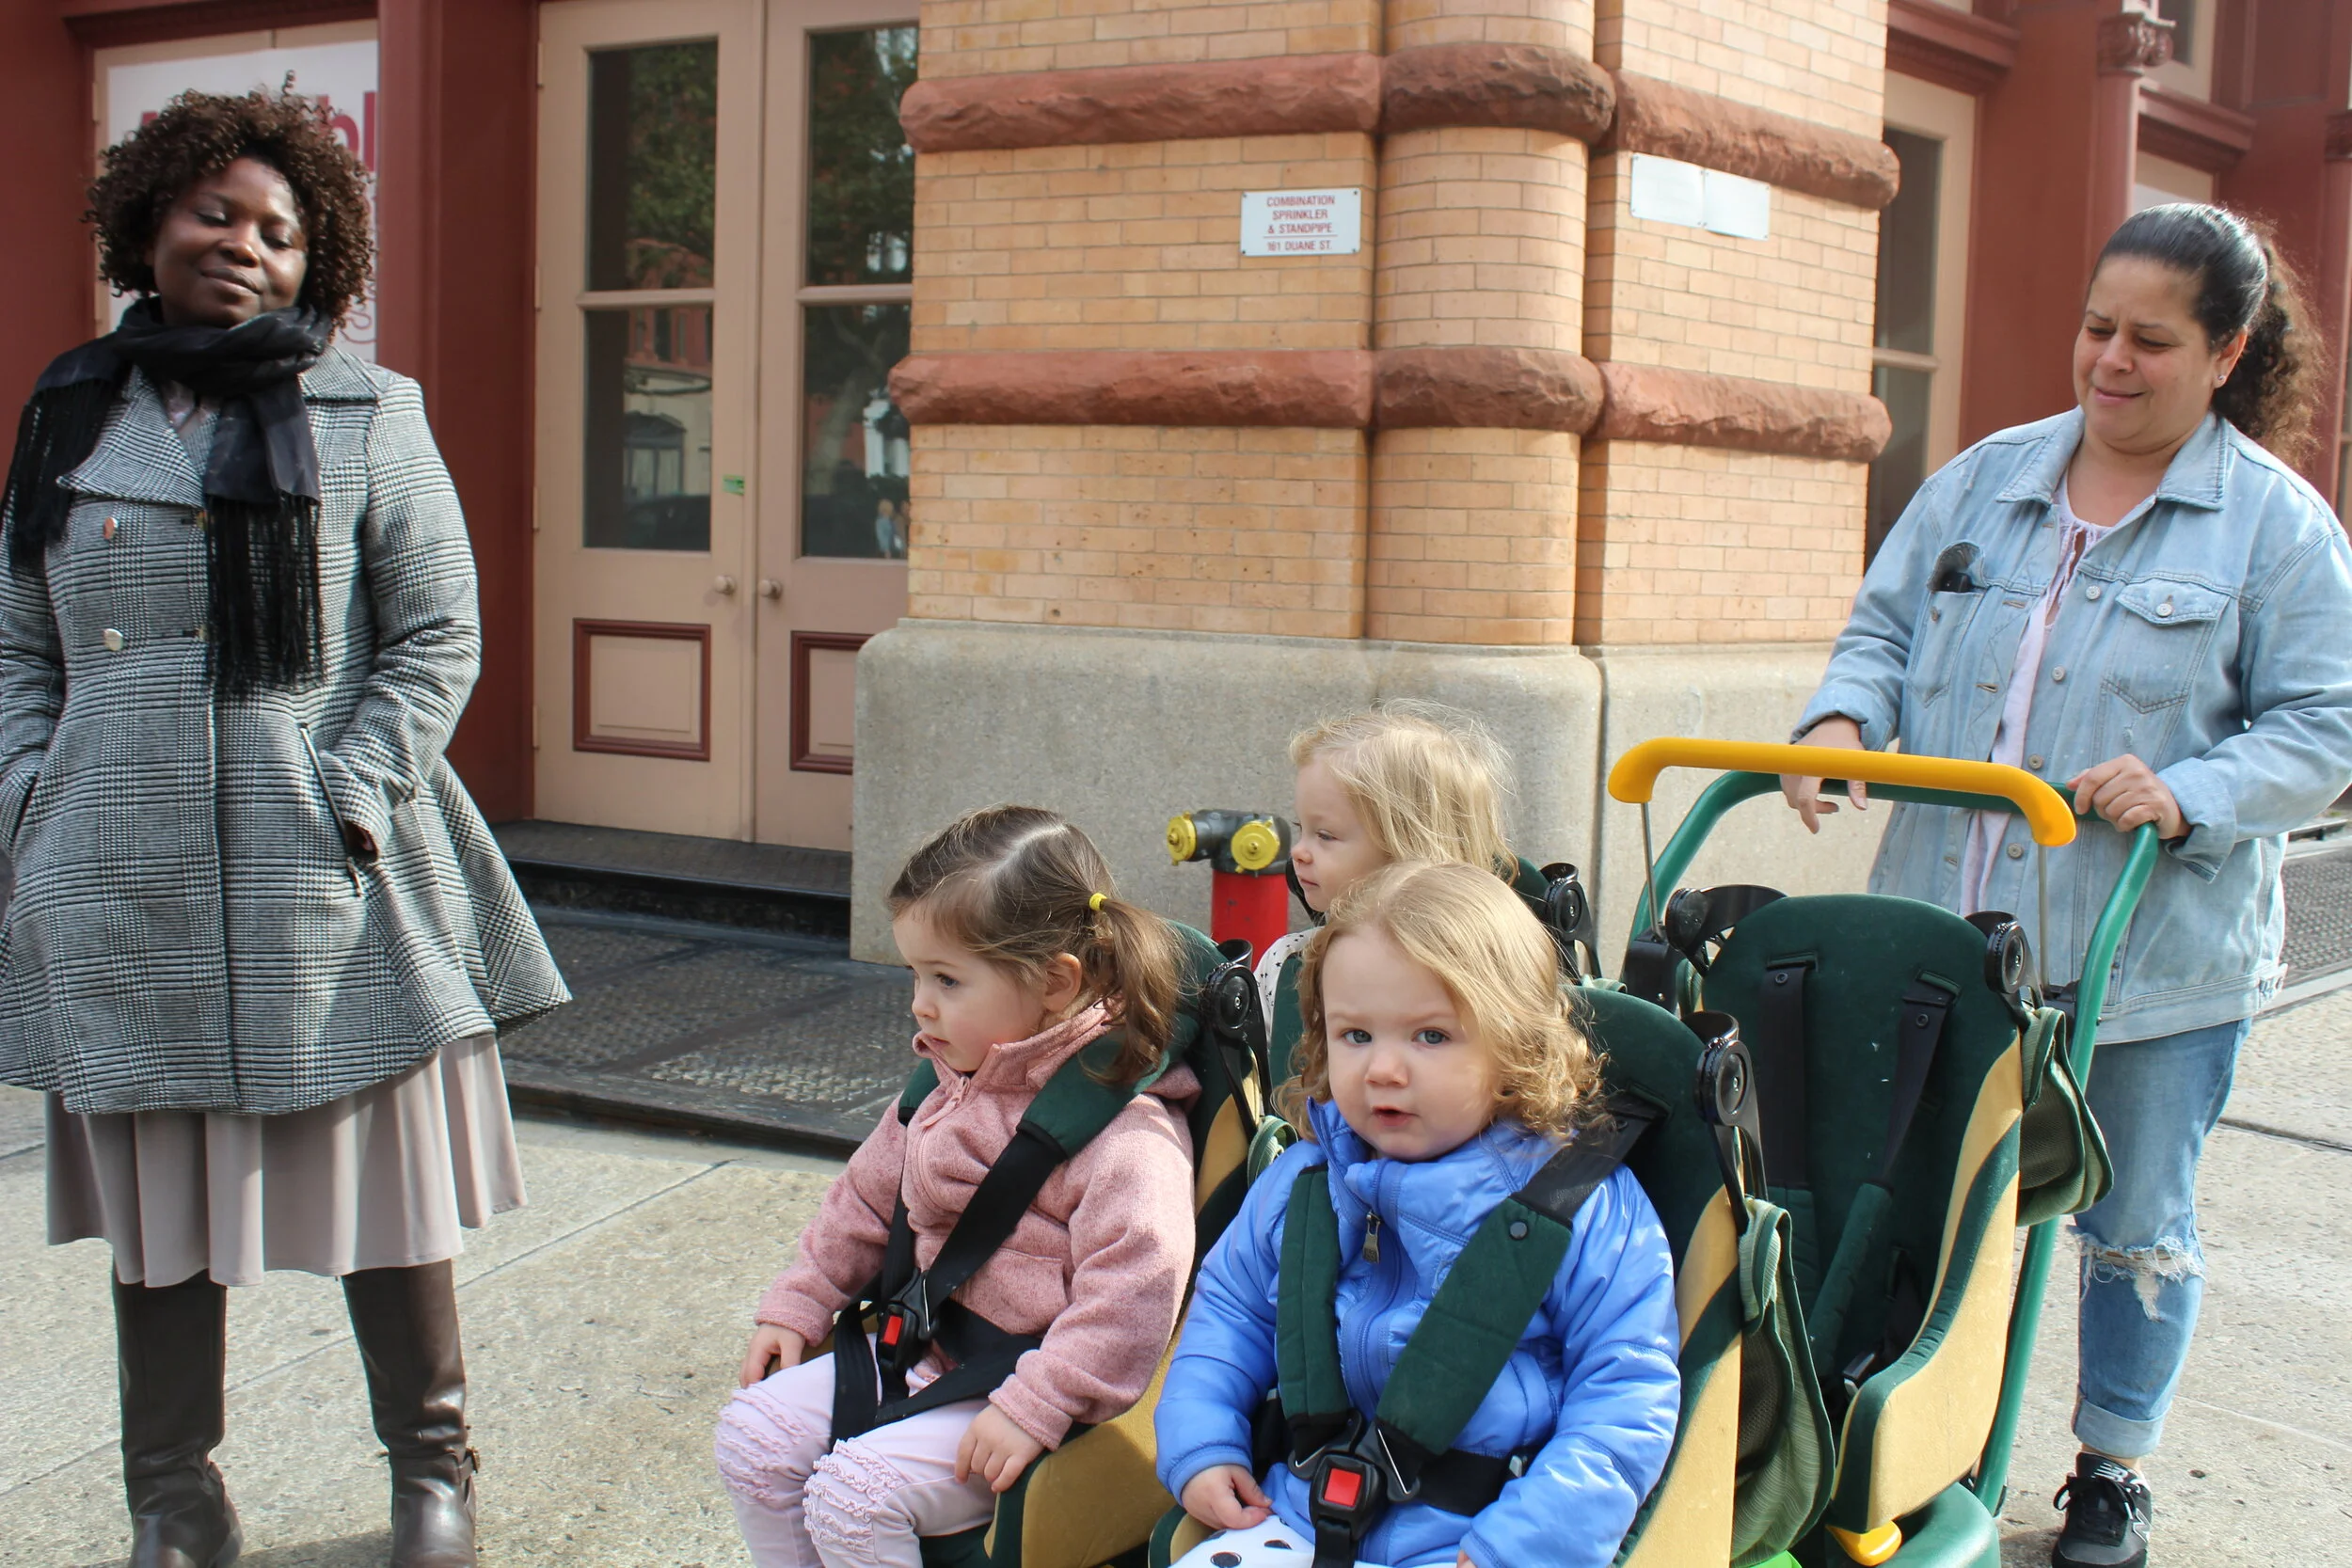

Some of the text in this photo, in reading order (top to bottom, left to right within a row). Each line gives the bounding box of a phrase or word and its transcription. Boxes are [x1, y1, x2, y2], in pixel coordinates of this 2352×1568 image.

[1266, 195, 1336, 207] COMBINATION
[1272, 209, 1328, 220] SPRINKLER
[1267, 222, 1333, 234] & STANDPIPE
[1285, 240, 1316, 251] DUANE
